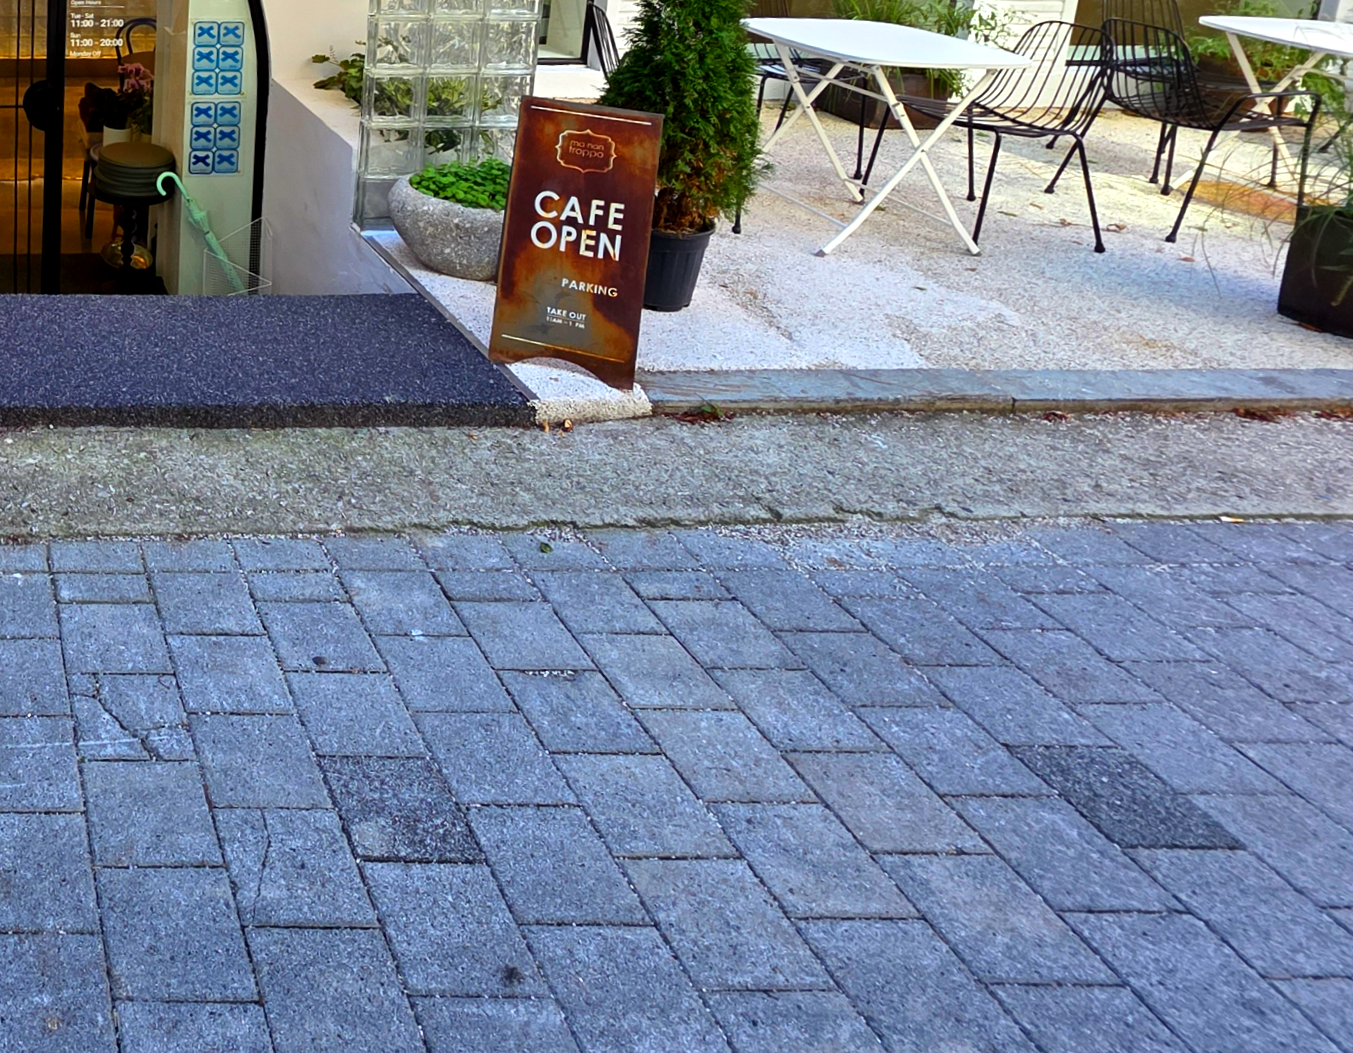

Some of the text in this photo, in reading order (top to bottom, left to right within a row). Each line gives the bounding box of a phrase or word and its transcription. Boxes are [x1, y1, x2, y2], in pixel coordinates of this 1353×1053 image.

[71, 19, 94, 27] 11:00
[100, 19, 124, 27] 21:00
[70, 39, 93, 47] 11:00
[100, 38, 123, 47] 20:00
[569, 146, 604, 158] troppo
[587, 142, 604, 151] non
[534, 190, 625, 230] CAFE
[530, 220, 622, 262] OPEN
[561, 277, 618, 297] PARKING
[547, 306, 586, 320] TAKE OUT
